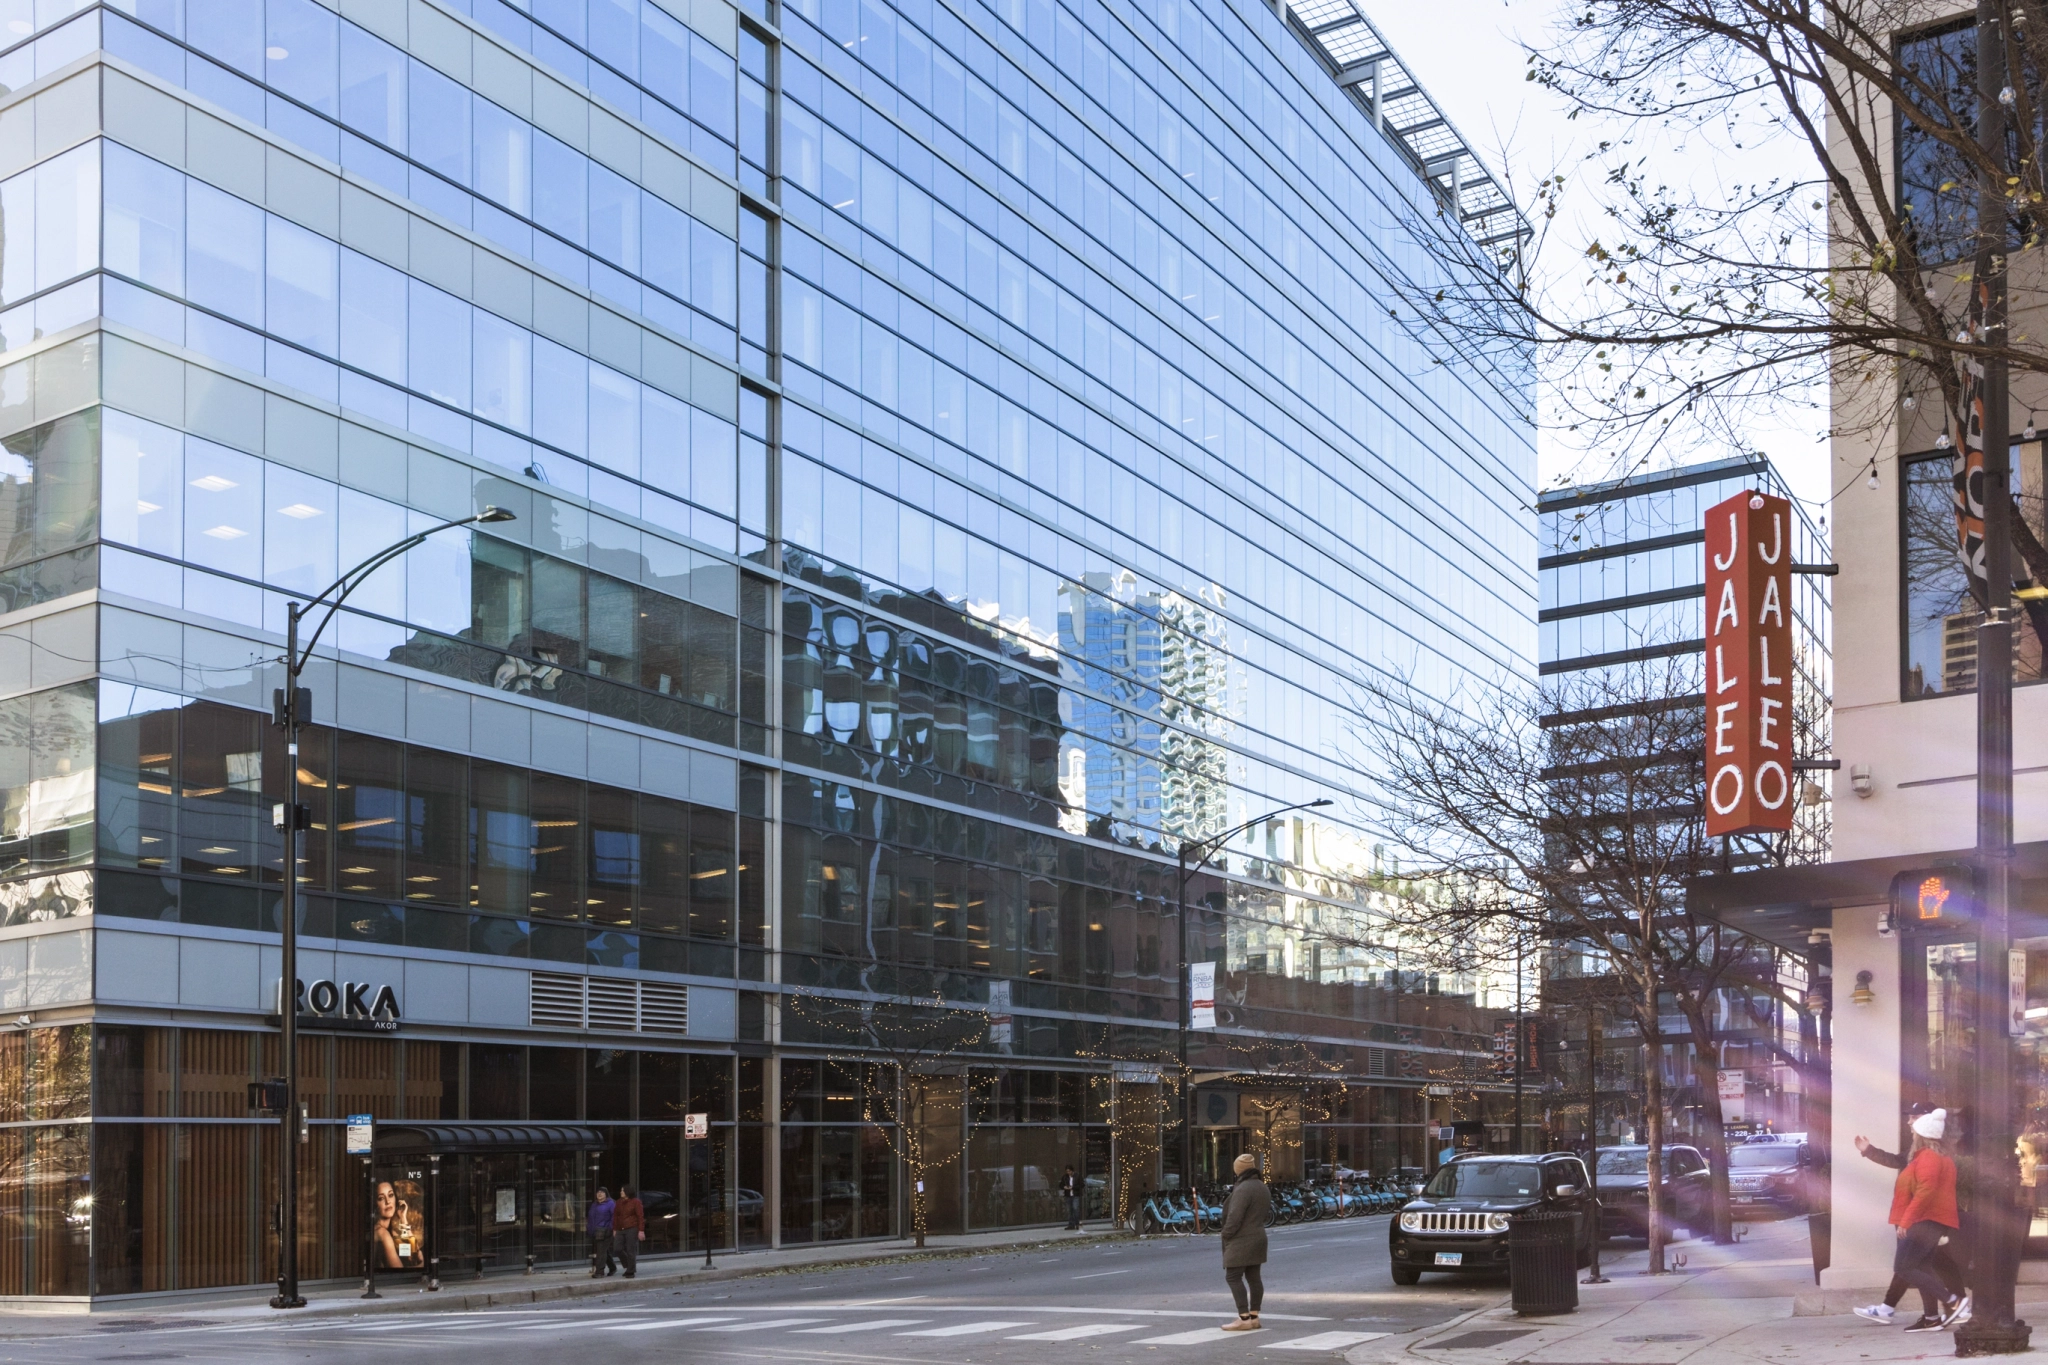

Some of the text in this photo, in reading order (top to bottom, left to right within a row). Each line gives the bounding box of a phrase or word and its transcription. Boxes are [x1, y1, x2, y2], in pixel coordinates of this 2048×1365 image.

[1710, 512, 1744, 815] JALEO
[1754, 512, 1788, 811] JALEO
[2012, 958, 2024, 977] ONE
[2012, 982, 2024, 1000] WAY
[1504, 1023, 1517, 1074] NORTH
